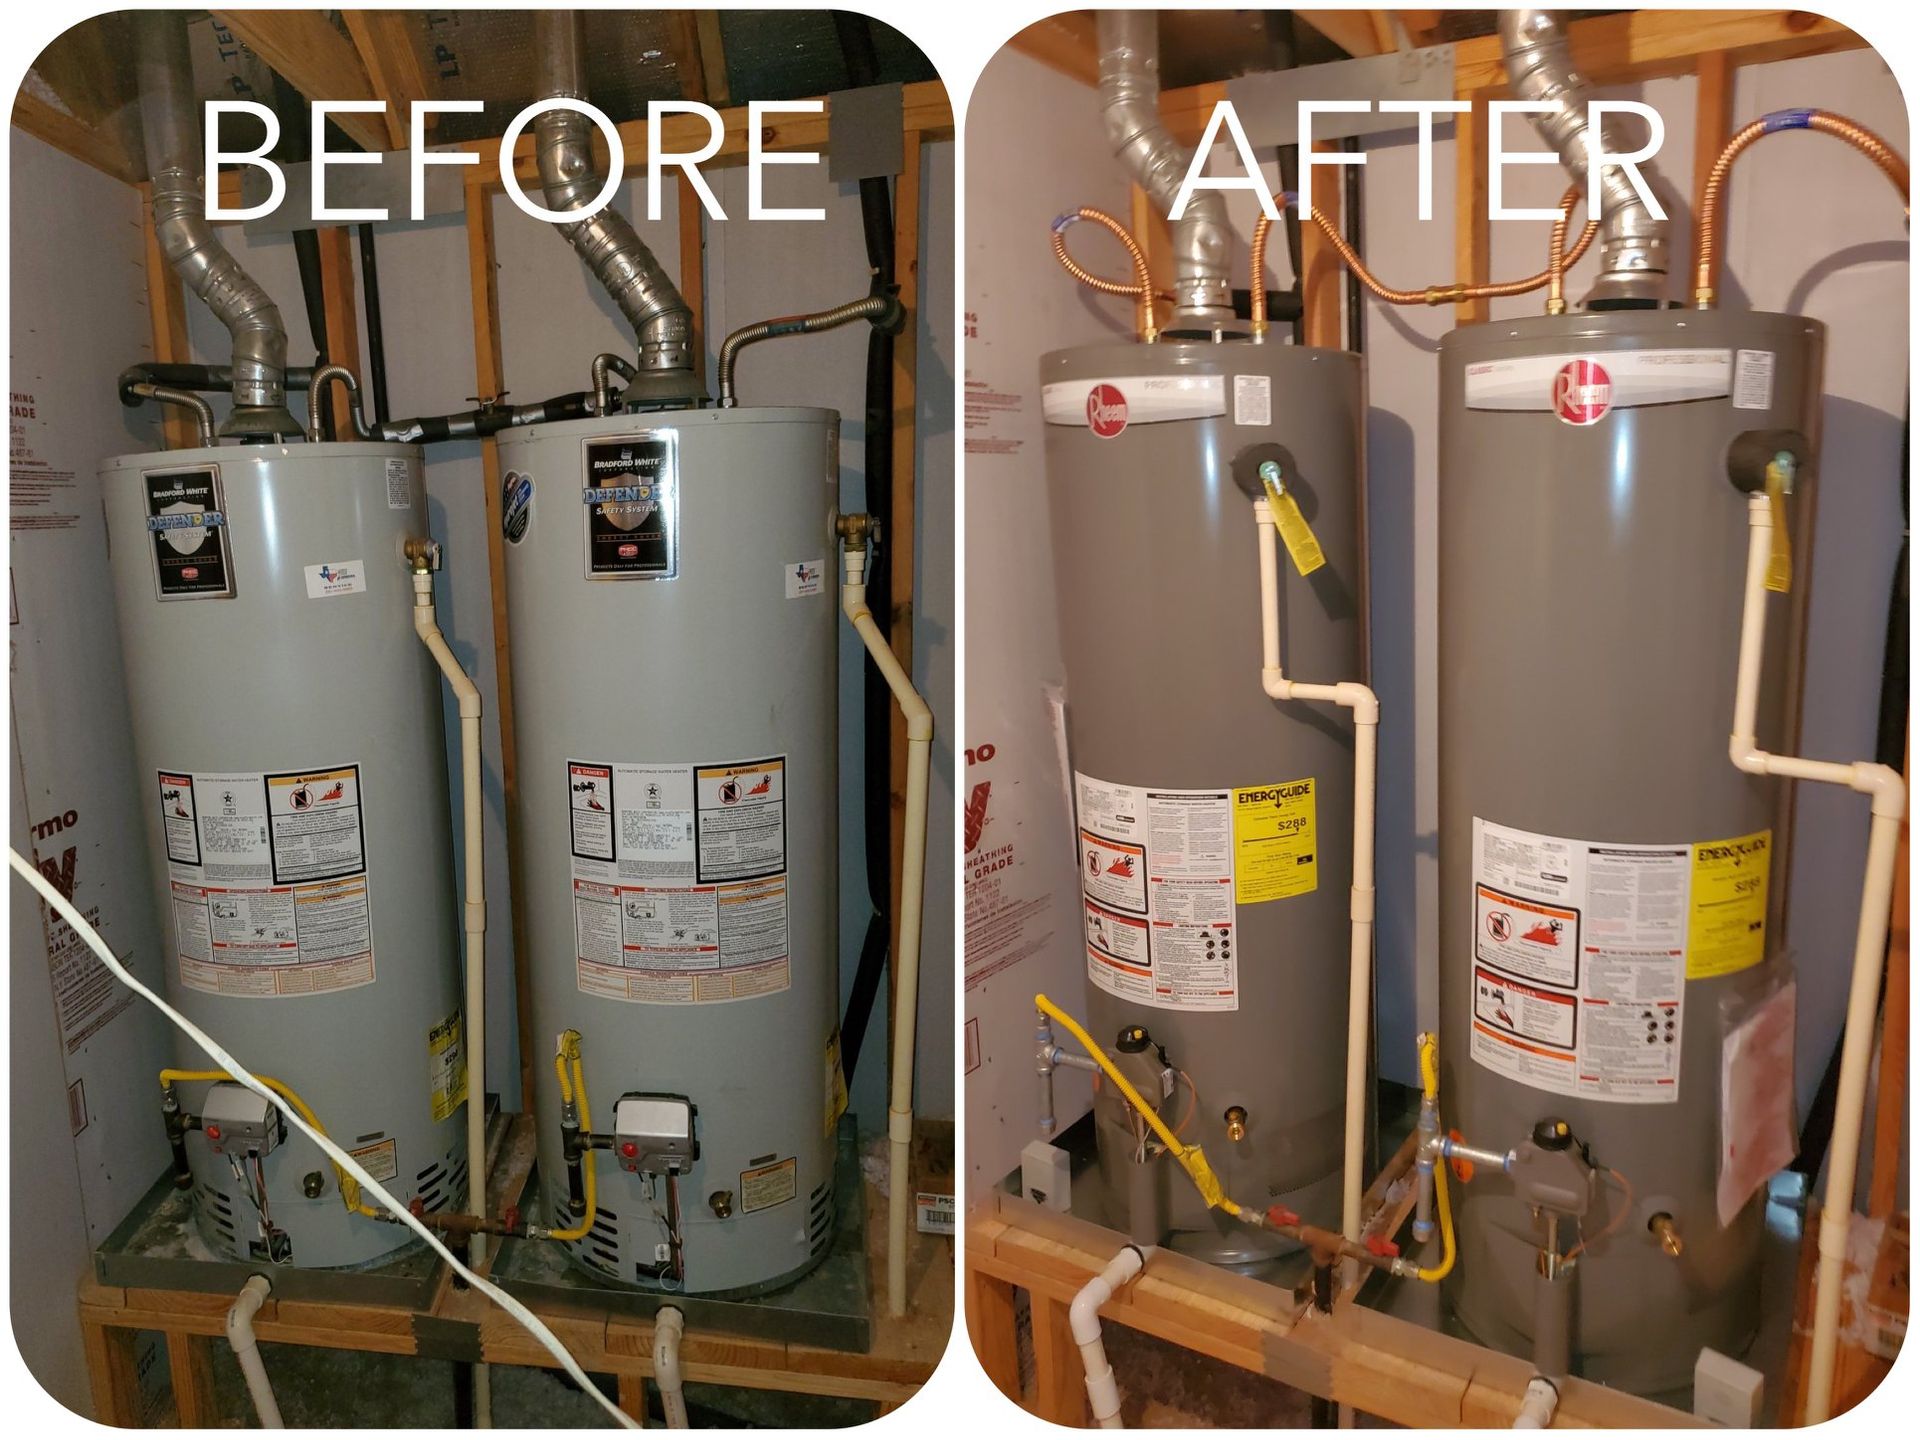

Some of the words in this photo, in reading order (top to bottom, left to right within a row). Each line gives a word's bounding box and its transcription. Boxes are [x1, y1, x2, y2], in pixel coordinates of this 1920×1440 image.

[593, 459, 633, 469] BRADFORD
[634, 458, 661, 468] WHITE
[153, 488, 185, 498] BRADFORD
[186, 487, 208, 496] WHITE
[583, 484, 676, 504] DEFENDE
[596, 506, 625, 516] SAFETY
[626, 504, 658, 514] SYSTEM
[147, 510, 225, 531] DEFENDER
[733, 767, 759, 775] WARNING
[1238, 783, 1311, 804] ENERGYGUIDE
[974, 855, 1014, 879] GRADE
